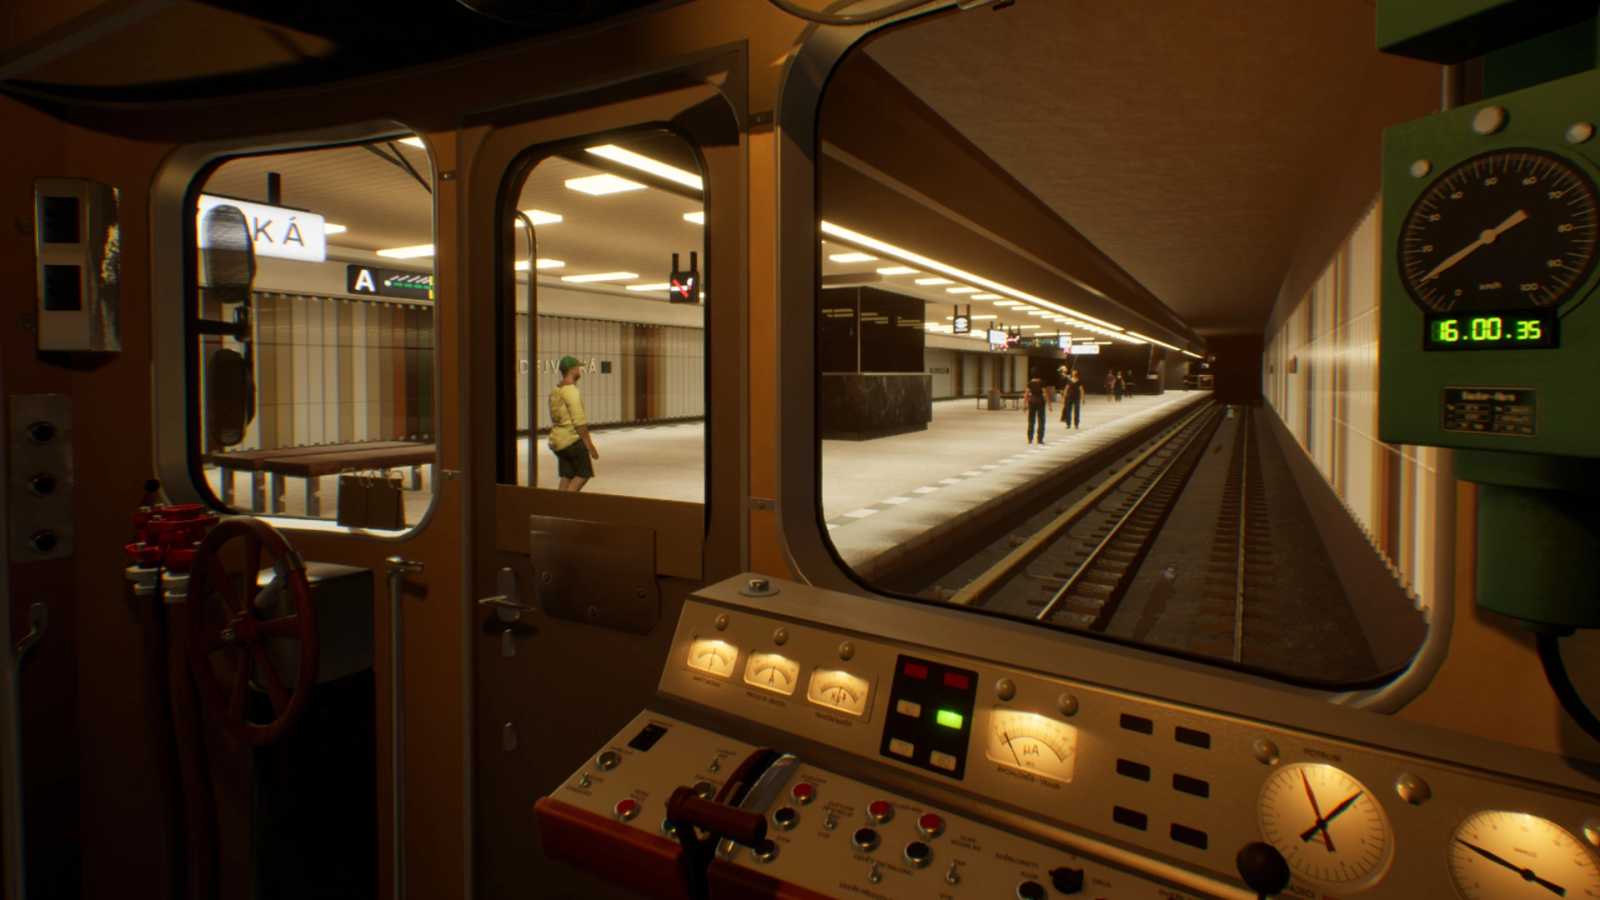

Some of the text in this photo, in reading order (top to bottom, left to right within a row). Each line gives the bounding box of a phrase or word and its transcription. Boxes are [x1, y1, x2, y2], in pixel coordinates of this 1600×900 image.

[253, 216, 304, 247] KÁ
[354, 269, 376, 292] A
[1439, 317, 1541, 342] 16.00.35
